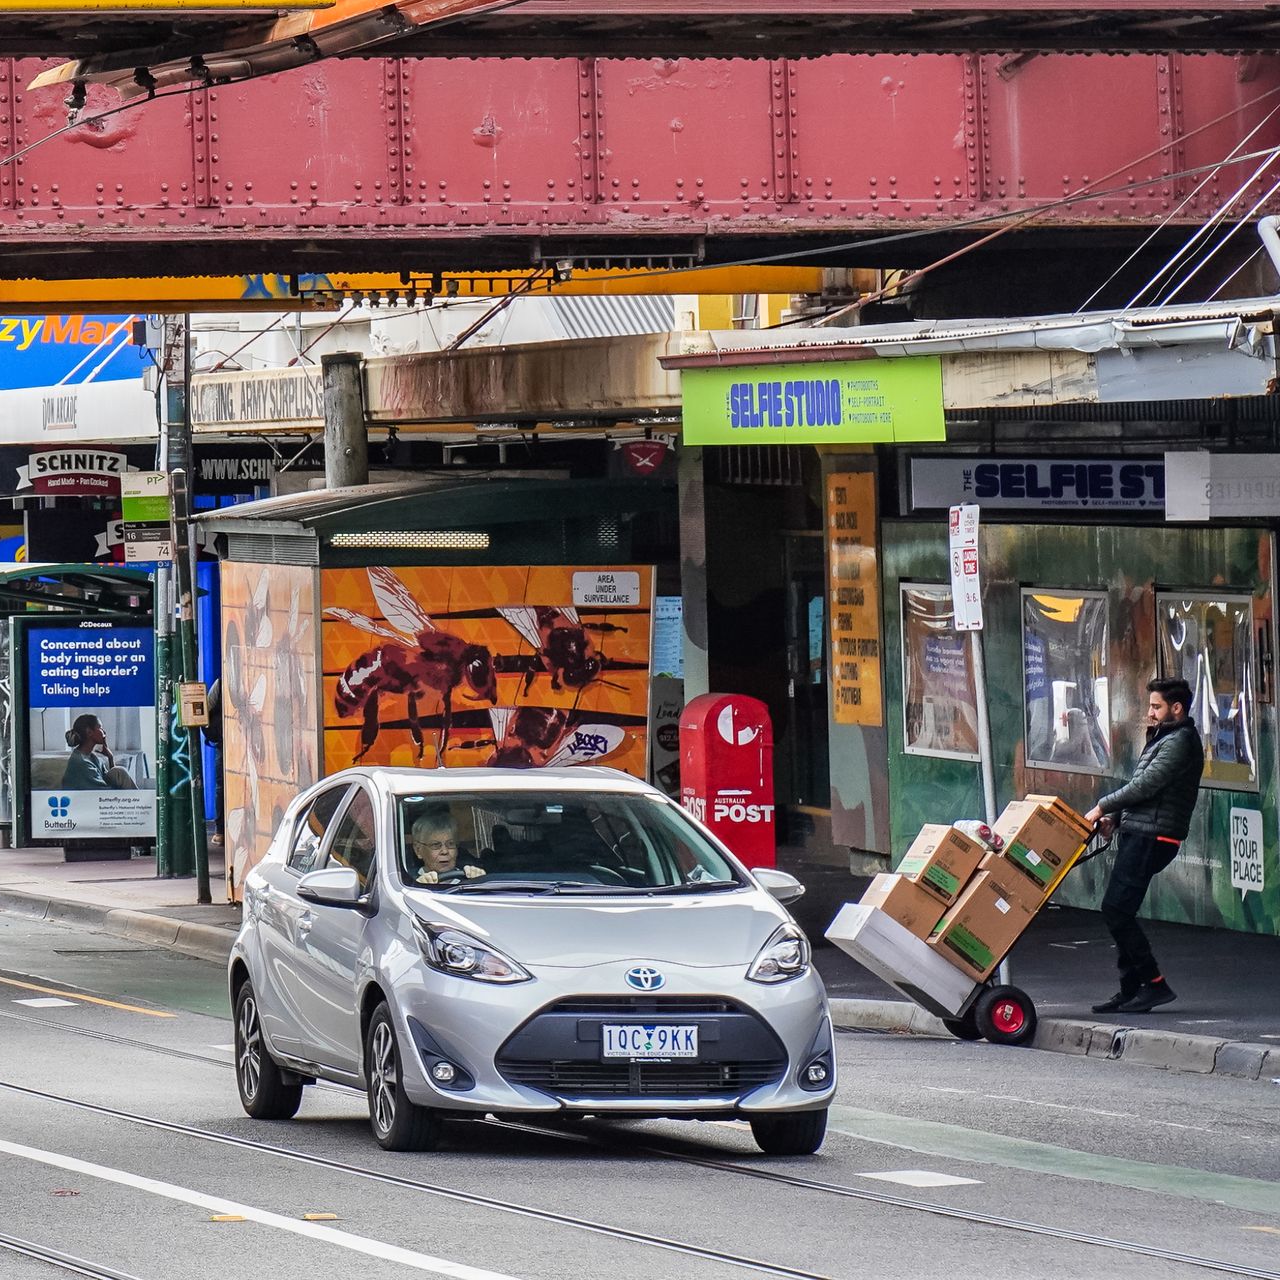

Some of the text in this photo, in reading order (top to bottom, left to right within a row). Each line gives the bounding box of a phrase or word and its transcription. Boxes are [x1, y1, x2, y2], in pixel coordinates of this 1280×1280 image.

[240, 377, 314, 419] ARMY SURPLUS
[730, 379, 842, 428] SELFIE STUDIO
[36, 453, 120, 473] SCHNITZ
[47, 477, 60, 487] Hand
[60, 477, 75, 486] Made
[90, 477, 109, 487] Cooked
[974, 464, 1165, 498] SELFIE ST
[126, 532, 137, 540] 16
[158, 546, 170, 556] 74
[597, 575, 615, 584] AREA
[595, 584, 617, 593] UNDER
[583, 594, 630, 604] SURVEILLANCE
[79, 621, 113, 629] JCDecaux
[40, 639, 141, 650] Concerned about
[41, 652, 146, 666] body image or an
[41, 665, 139, 679] eating disorder?
[42, 683, 111, 697] Talking helps
[714, 805, 775, 822] POST
[44, 819, 77, 830] Butterfly
[1233, 815, 1249, 837] IT'S
[1233, 837, 1258, 860] YOUR
[1233, 861, 1263, 884] PLACE
[607, 1029, 695, 1051] 1QC 9KK
